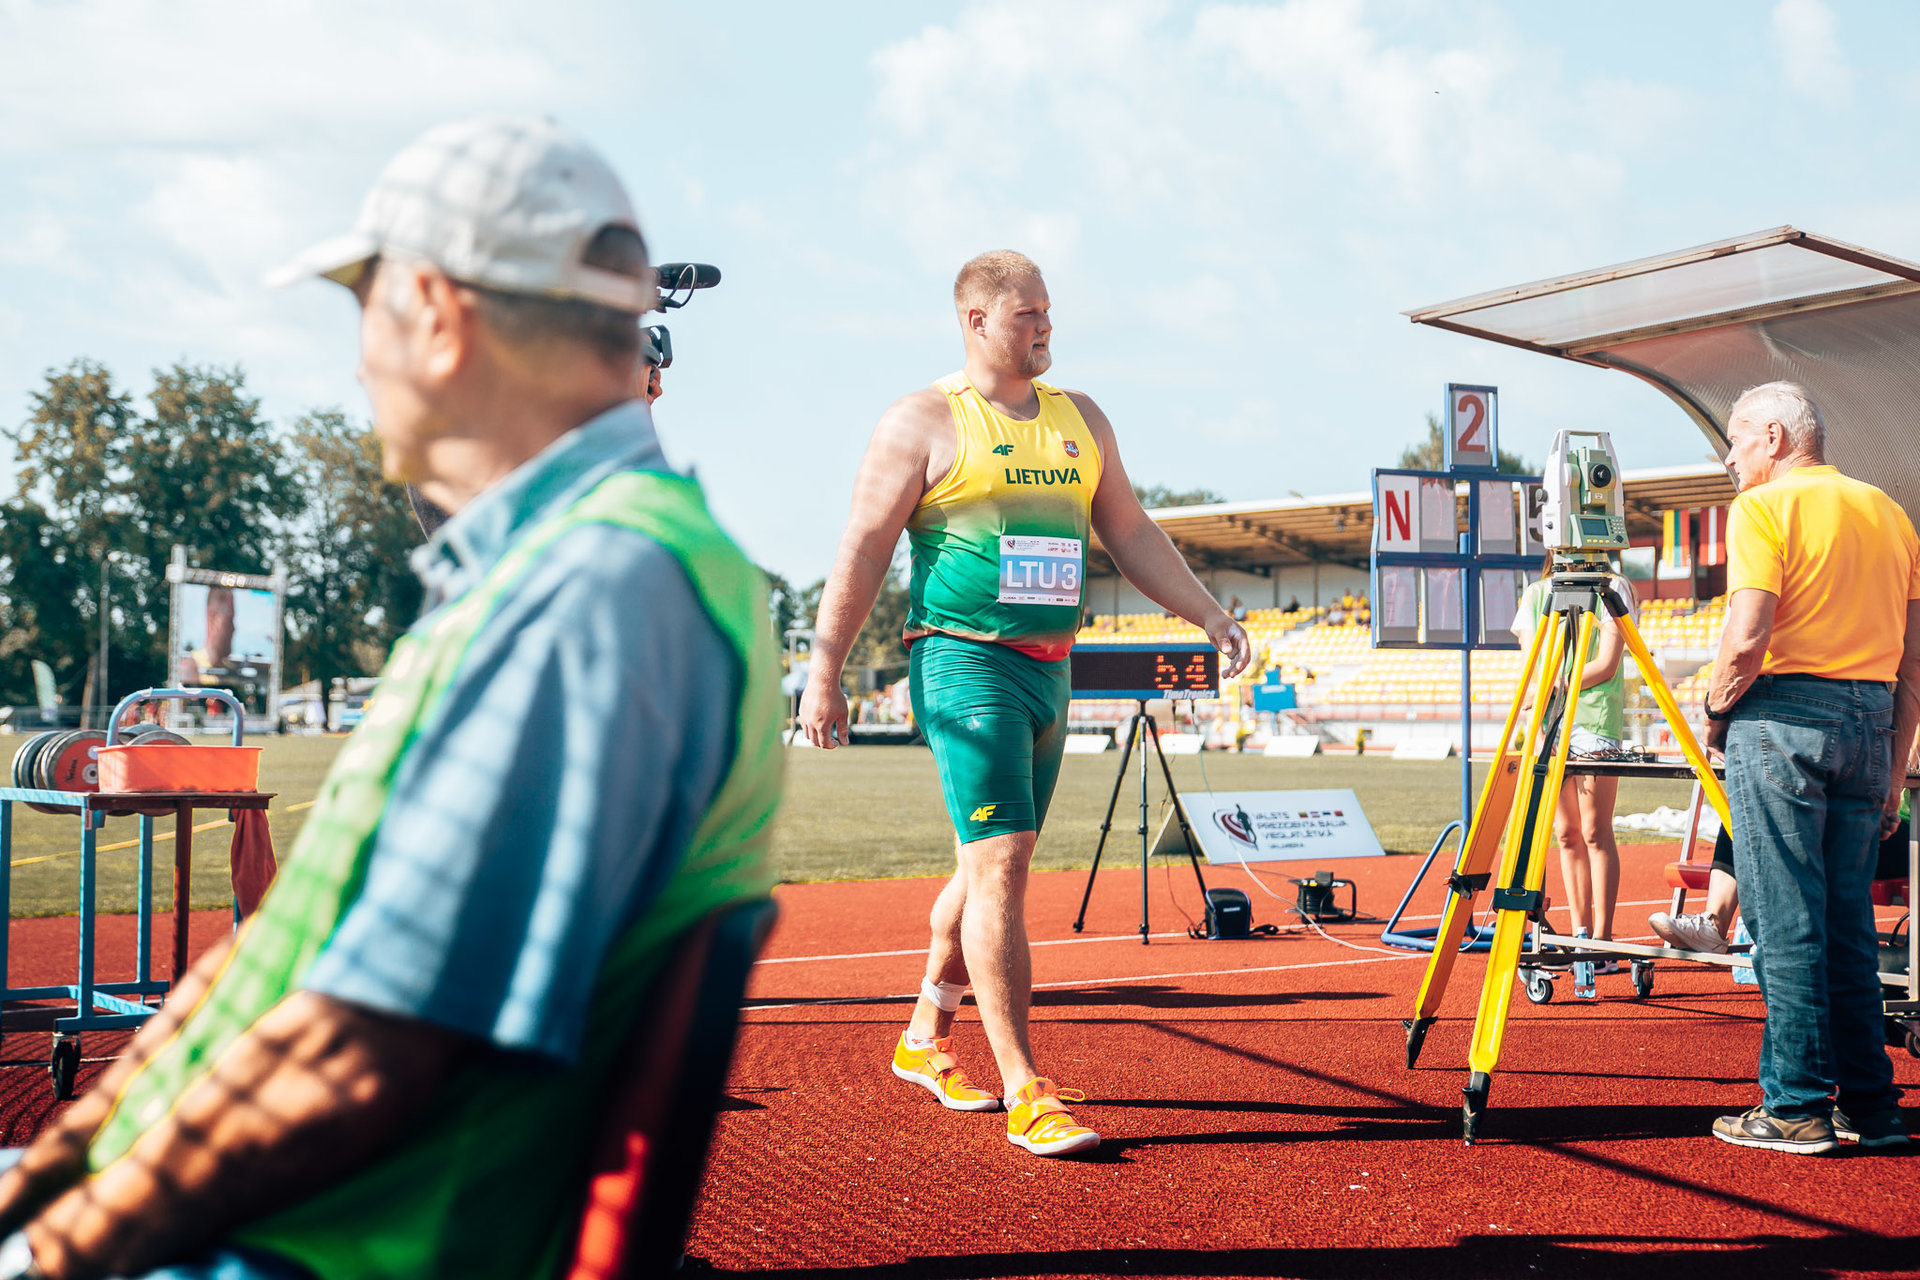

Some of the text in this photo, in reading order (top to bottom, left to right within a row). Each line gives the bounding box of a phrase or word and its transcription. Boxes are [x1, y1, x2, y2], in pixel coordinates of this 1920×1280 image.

[1457, 394, 1486, 453] 2
[992, 444, 1014, 456] 4F
[1005, 468, 1081, 485] LIETUVA
[1385, 490, 1411, 541] N
[1163, 689, 1216, 700] TimeTronics
[969, 804, 997, 822] 4F
